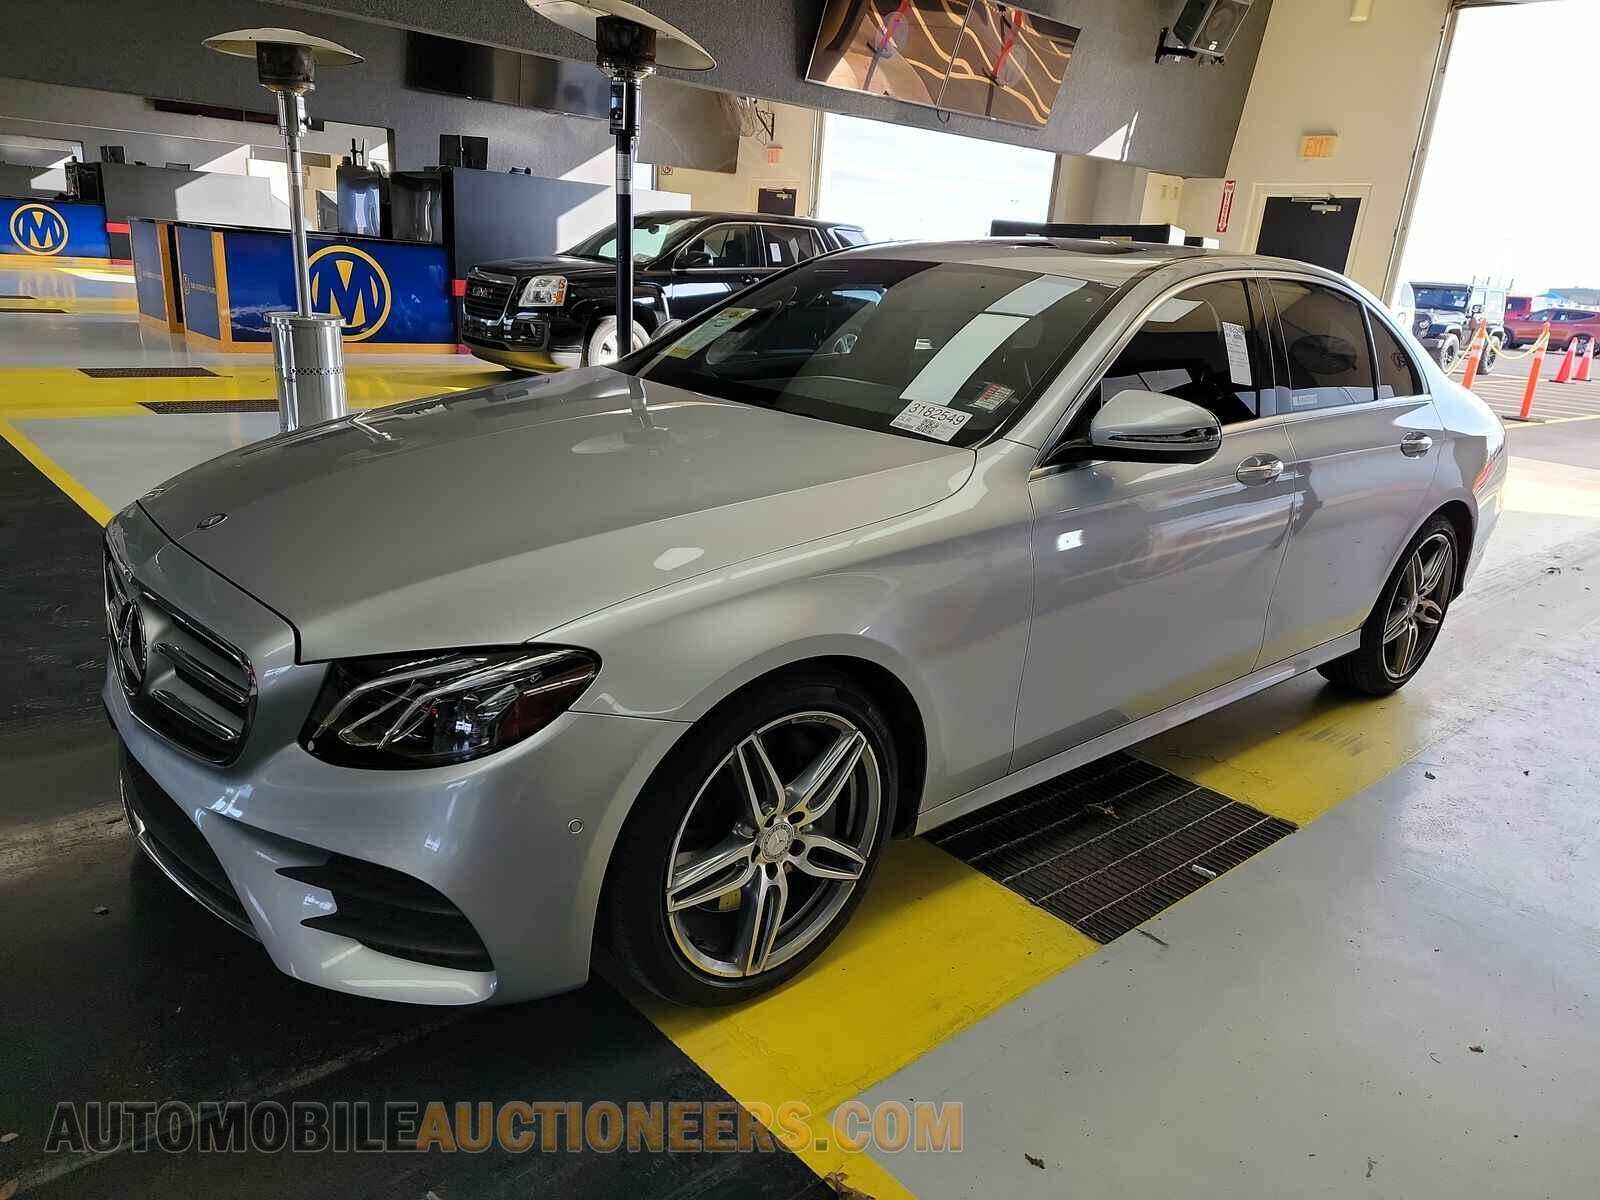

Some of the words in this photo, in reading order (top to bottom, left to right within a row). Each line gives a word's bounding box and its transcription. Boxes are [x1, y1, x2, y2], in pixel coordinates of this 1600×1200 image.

[20, 210, 60, 249] M
[313, 258, 379, 328] M
[908, 402, 966, 426] 3182549
